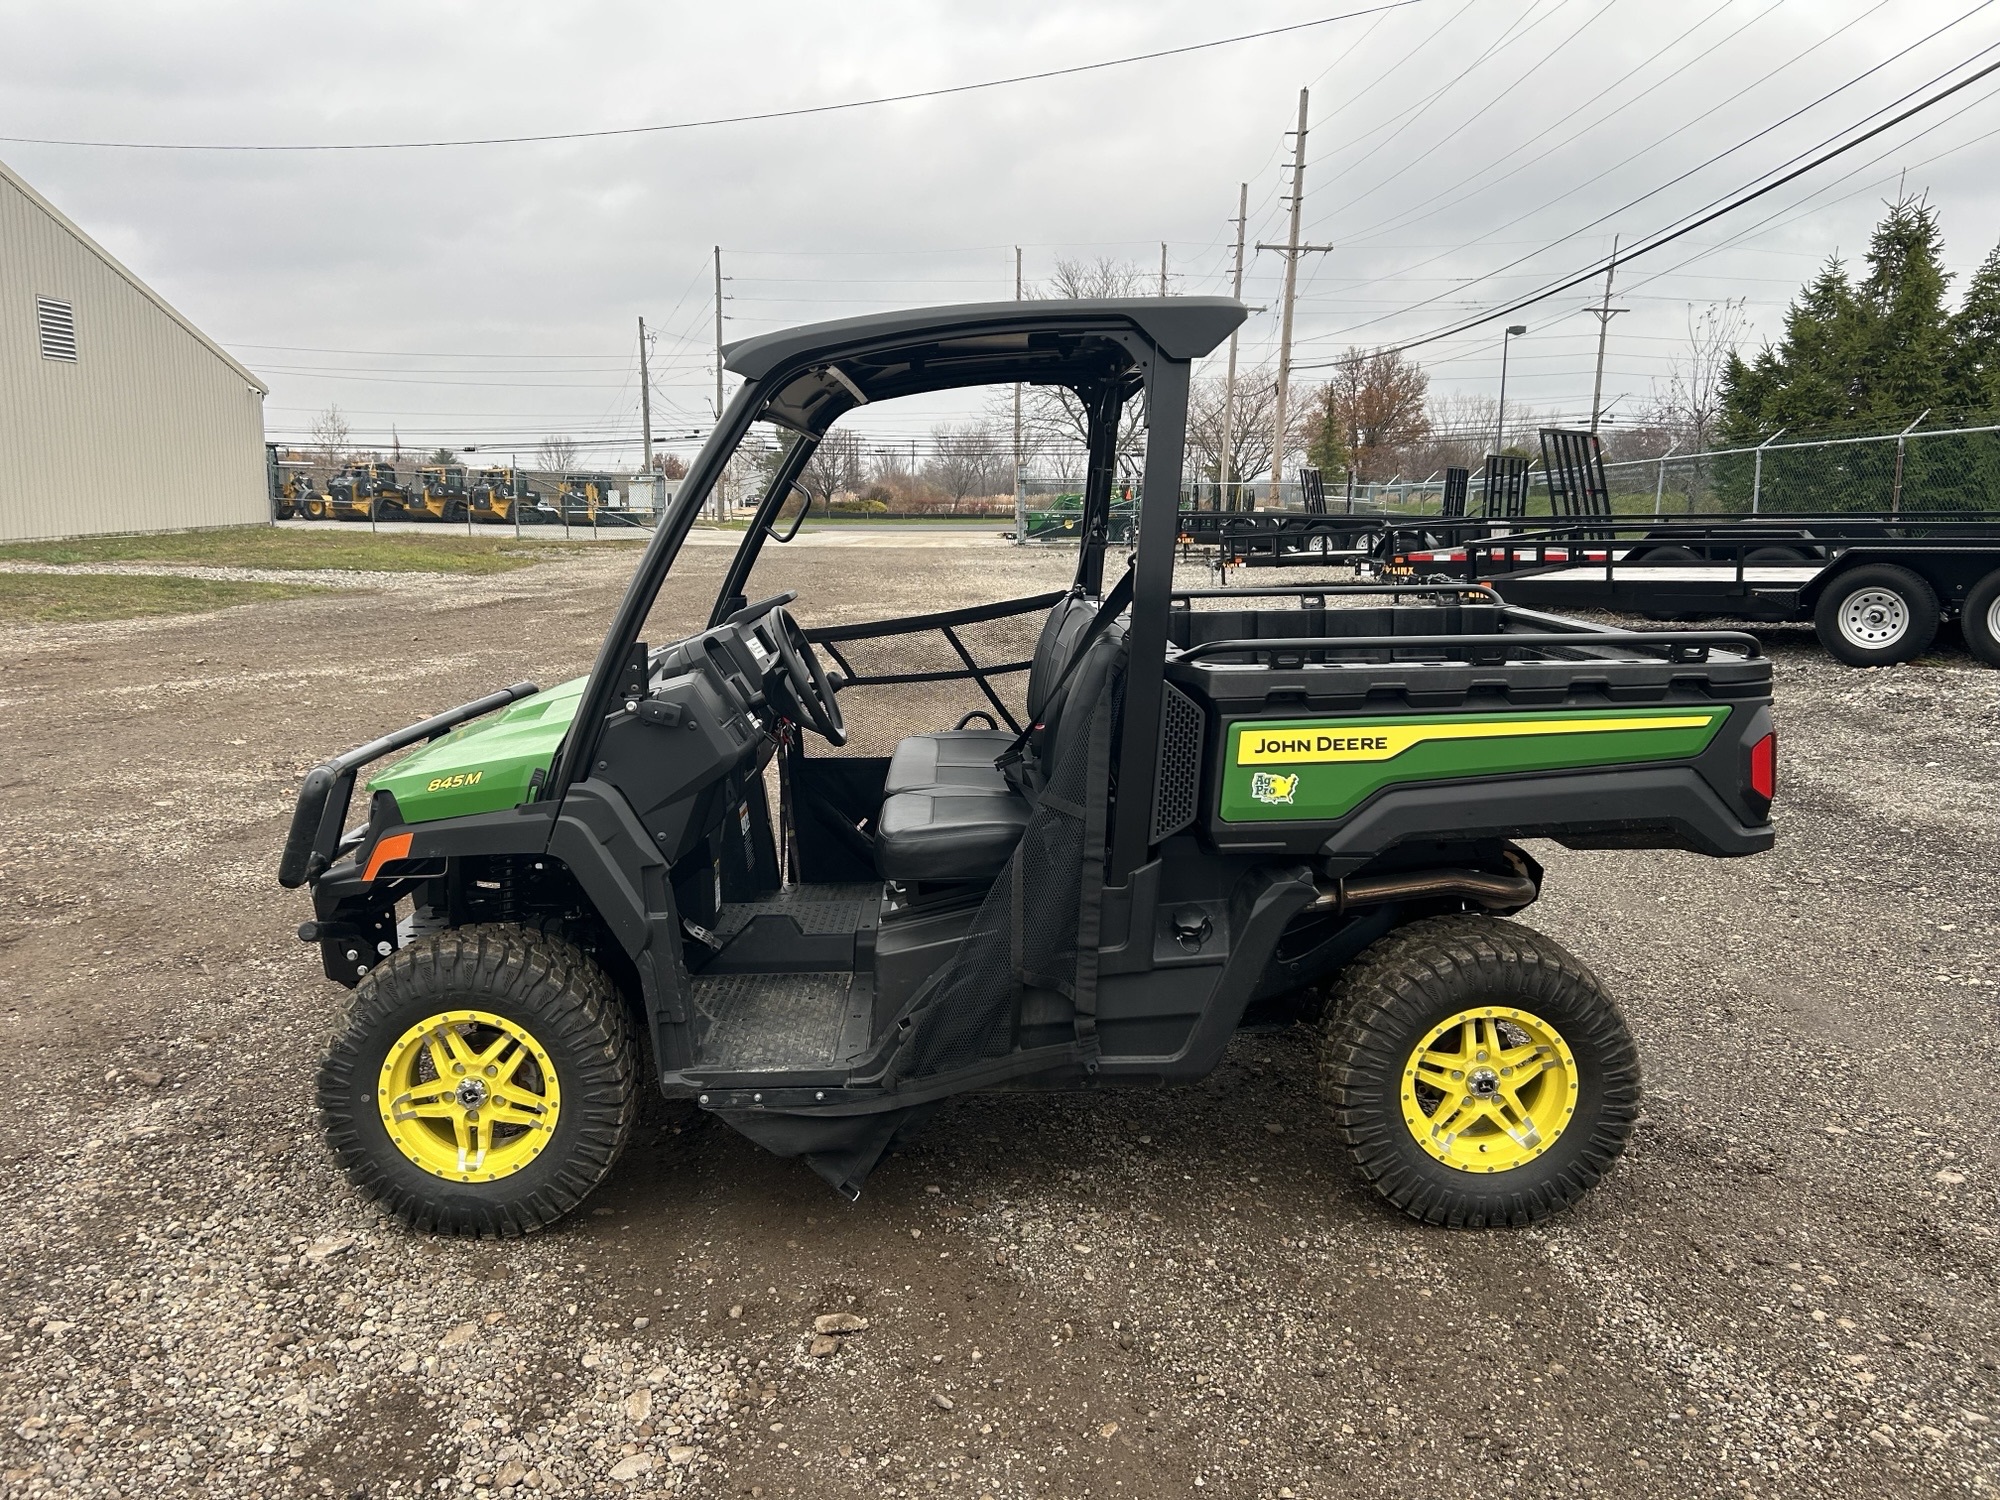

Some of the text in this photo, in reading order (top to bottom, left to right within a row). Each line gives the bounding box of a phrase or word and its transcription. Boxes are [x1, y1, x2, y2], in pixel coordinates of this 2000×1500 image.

[1254, 736, 1388, 754] JOHN DEERE
[427, 770, 483, 793] 845M
[1255, 786, 1276, 796] Pro
